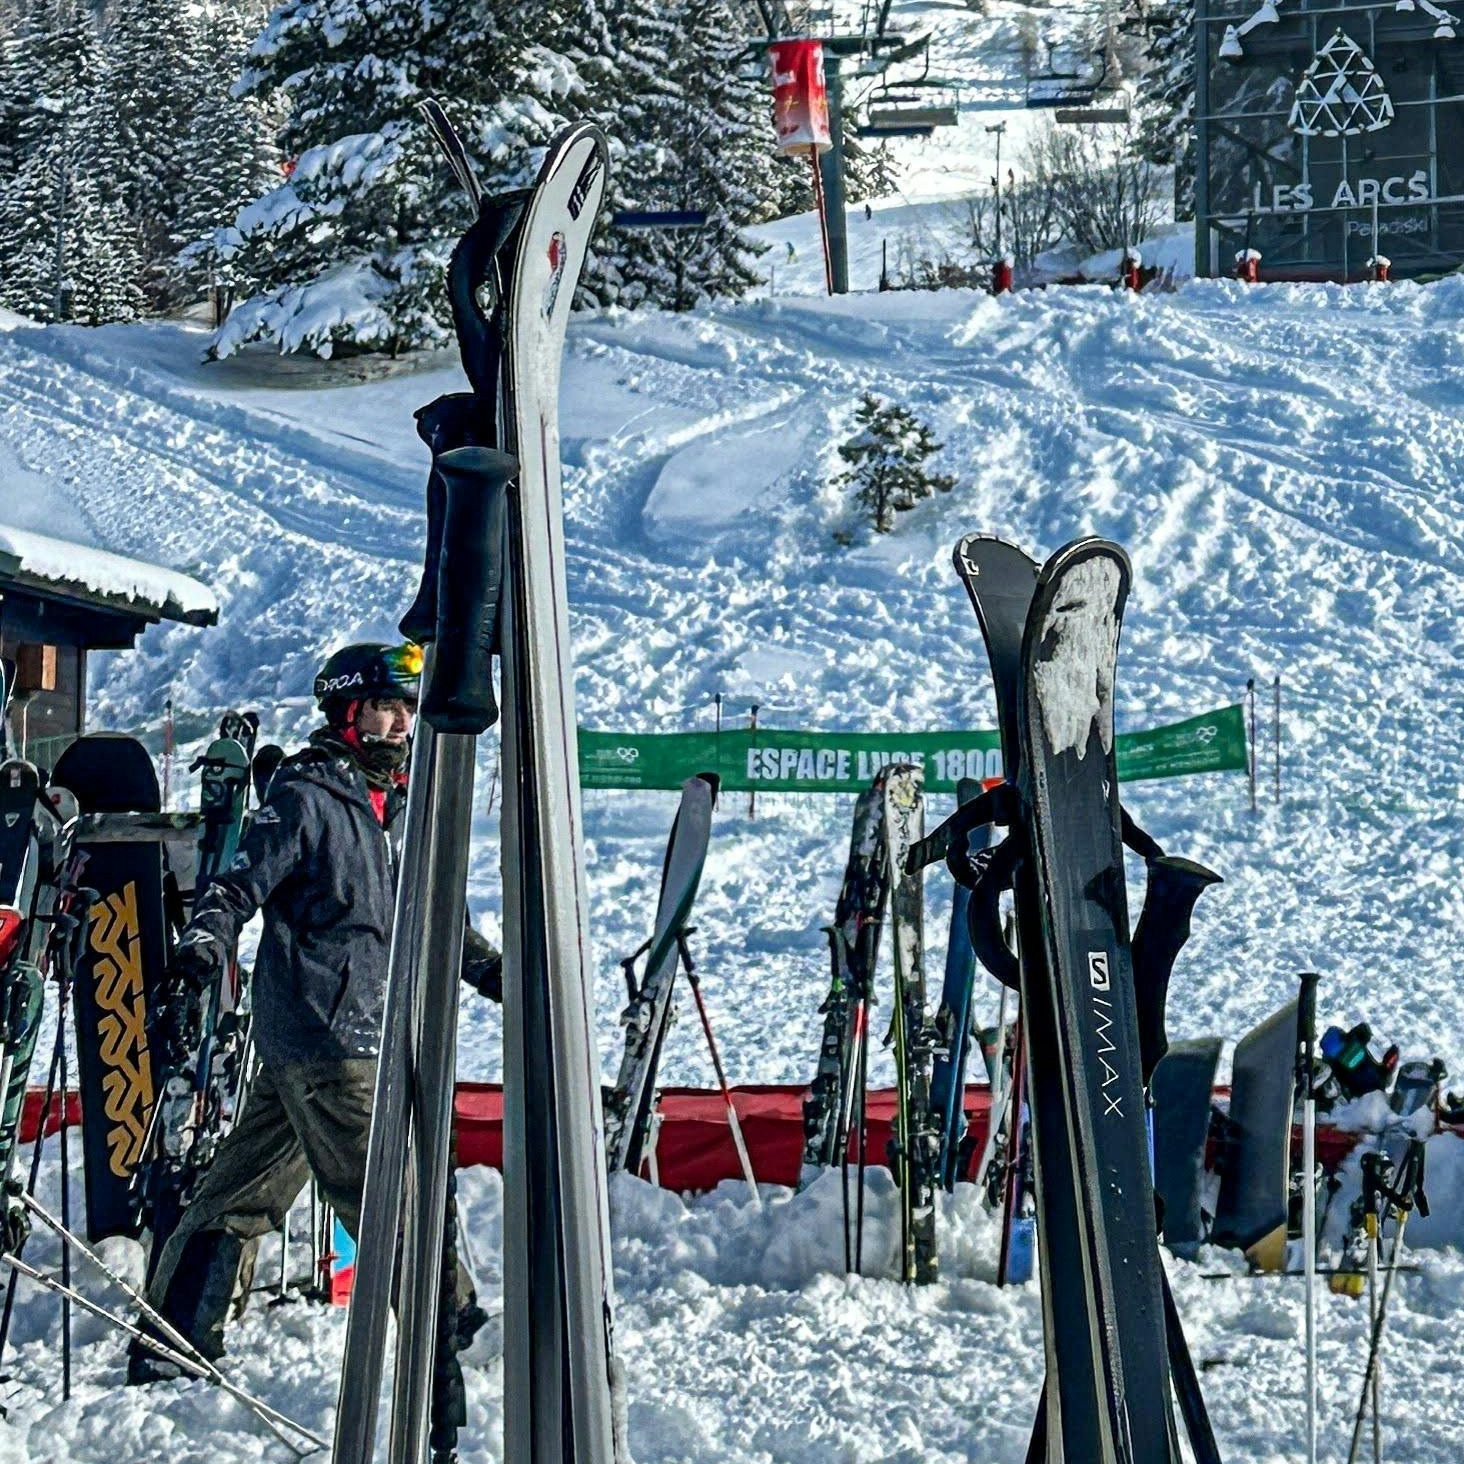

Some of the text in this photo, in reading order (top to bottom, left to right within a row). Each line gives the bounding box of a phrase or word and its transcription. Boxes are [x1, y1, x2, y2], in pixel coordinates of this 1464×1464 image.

[1254, 173, 1429, 213] LES ARCS
[747, 748, 849, 780] ESPACE
[931, 749, 1004, 781] 1800
